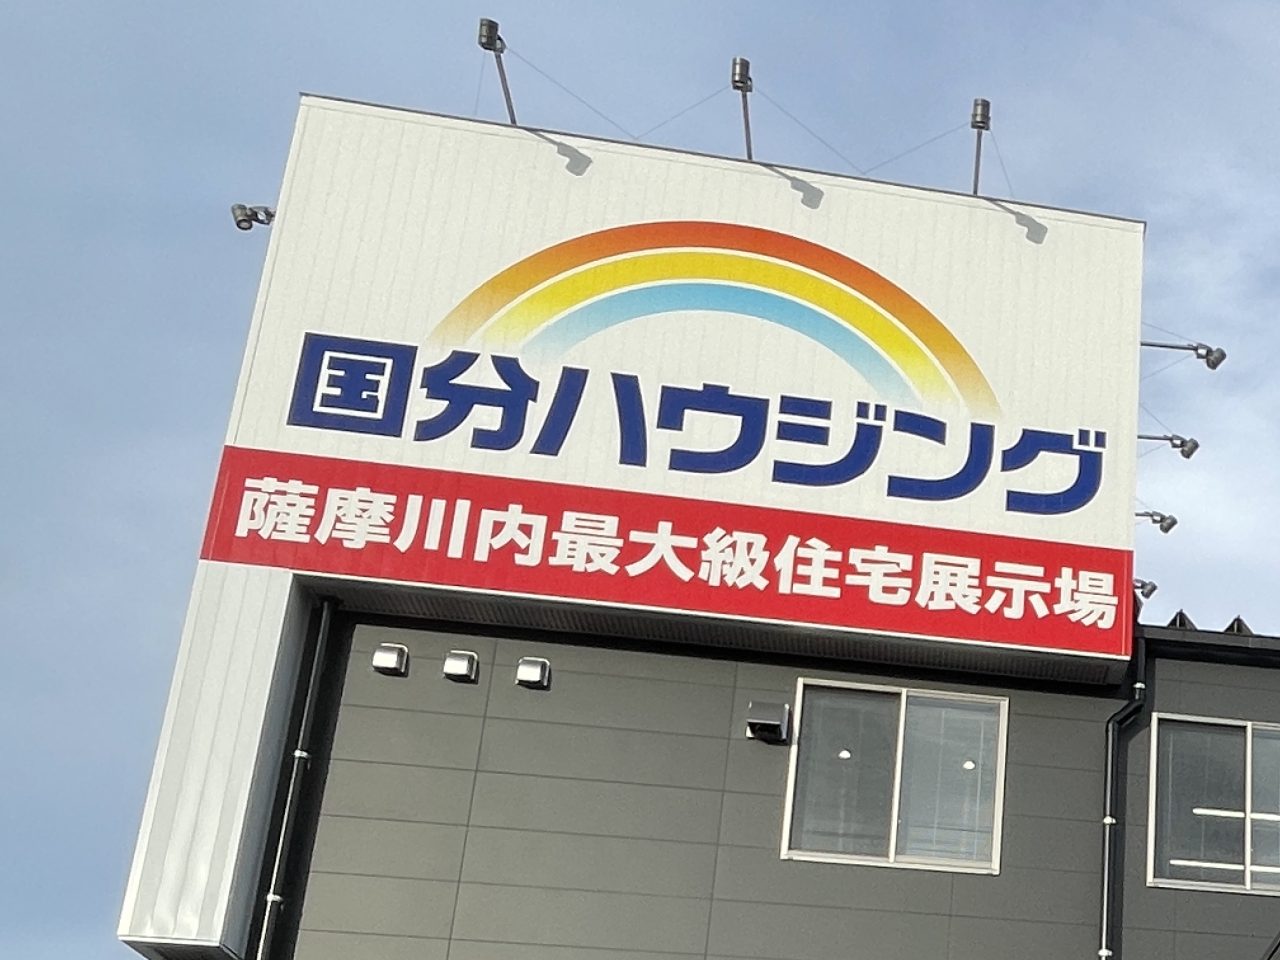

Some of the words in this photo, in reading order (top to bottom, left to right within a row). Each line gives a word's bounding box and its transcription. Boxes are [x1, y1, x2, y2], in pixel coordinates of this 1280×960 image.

[286, 331, 1108, 516] 国分ハウジング
[233, 474, 1121, 631] 薩摩川内最大級住宅展示場
